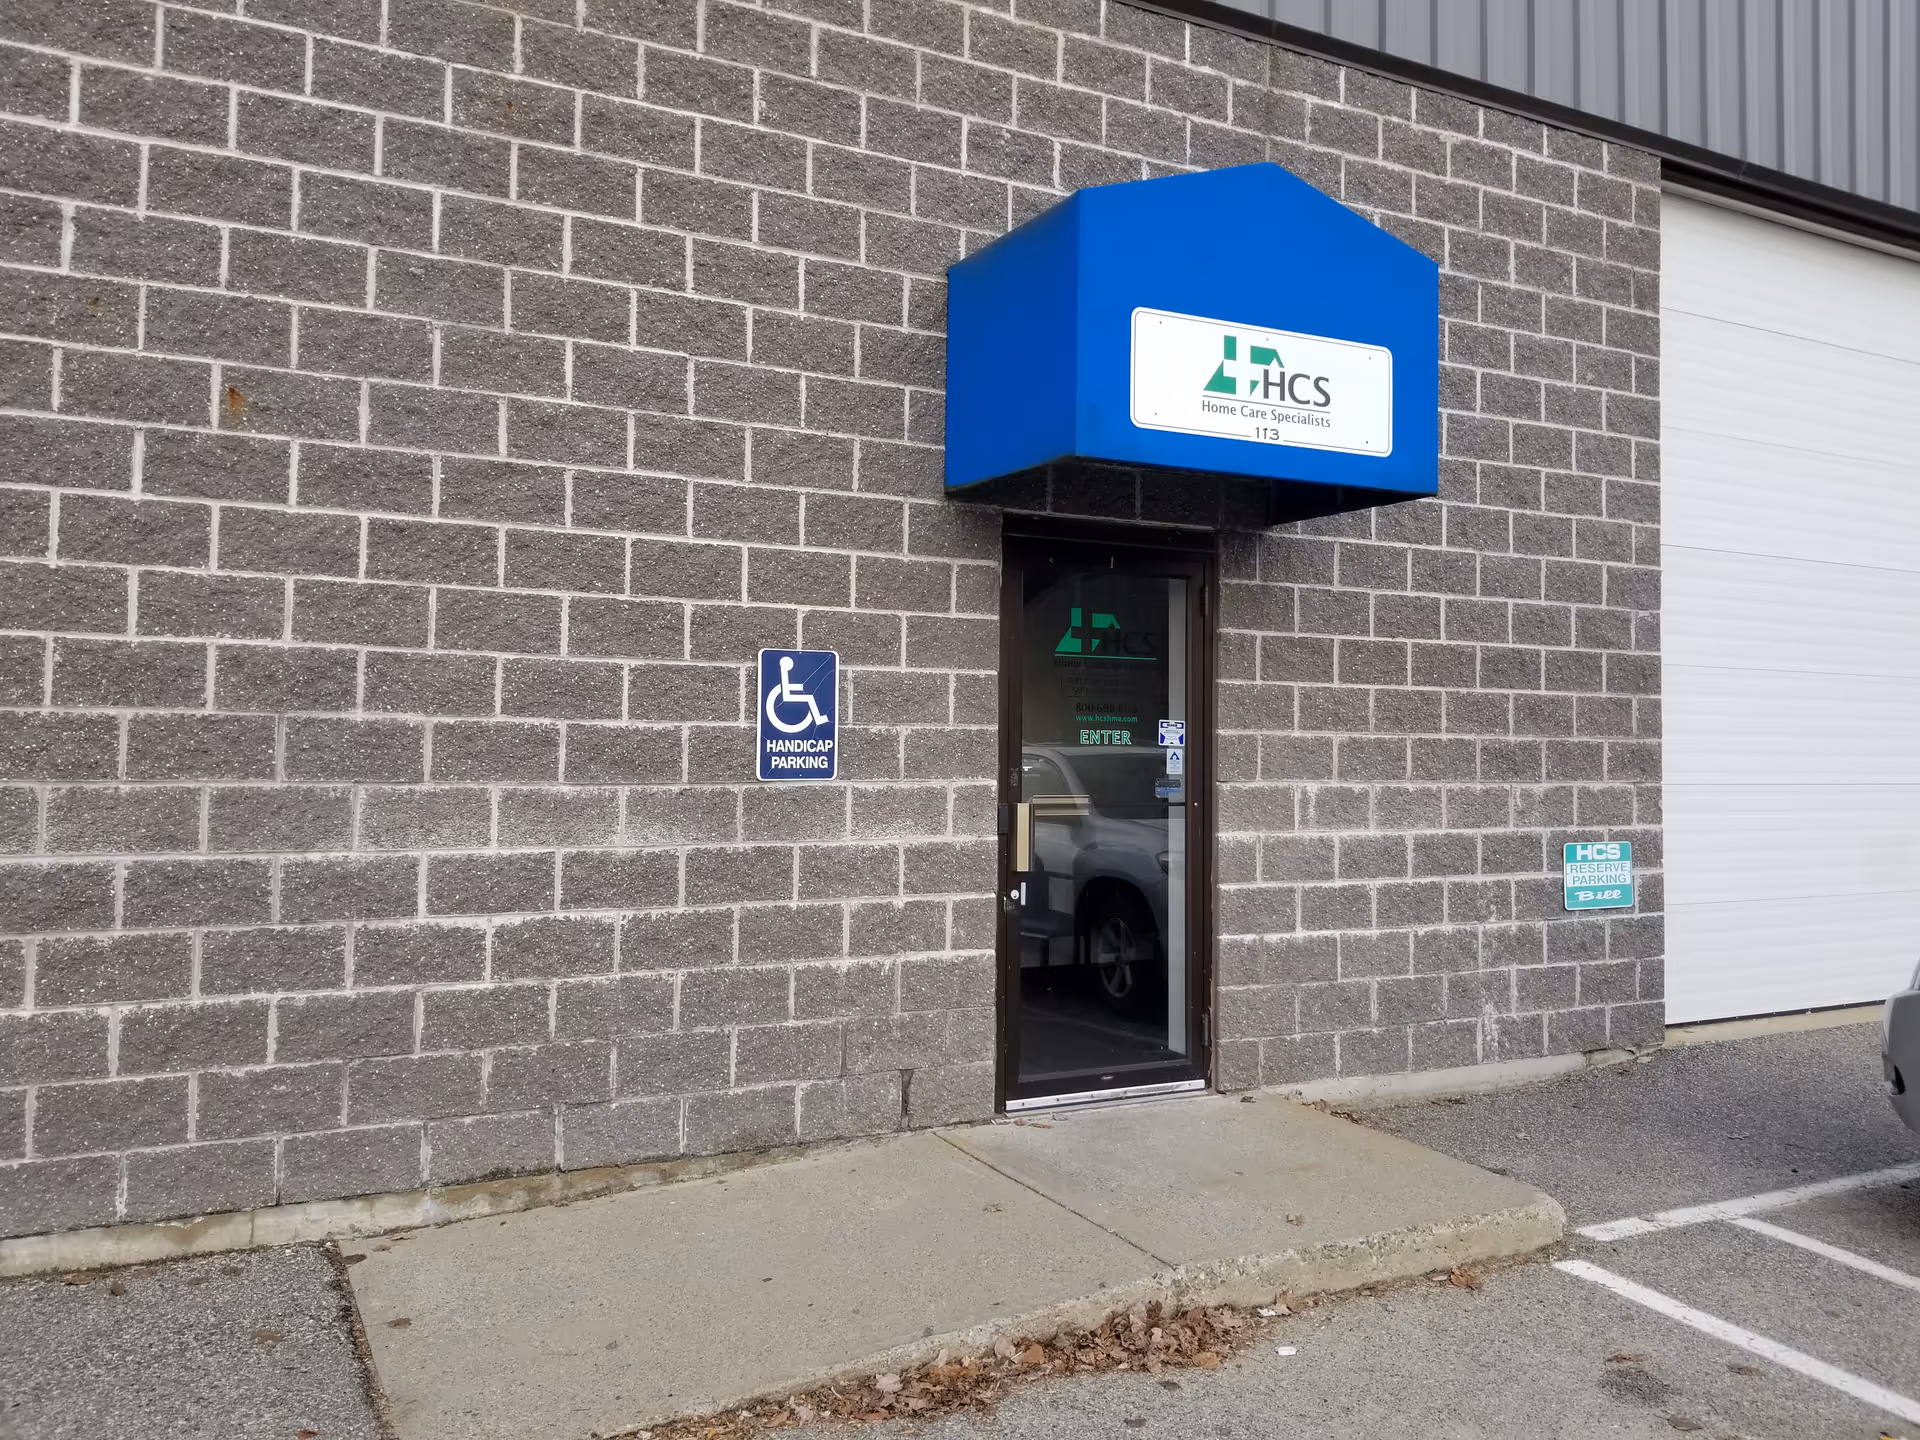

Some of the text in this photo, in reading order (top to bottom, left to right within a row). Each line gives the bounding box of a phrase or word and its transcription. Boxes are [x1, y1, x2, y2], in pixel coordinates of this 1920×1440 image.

[1263, 369, 1331, 407] HCS
[1202, 400, 1331, 428] Home Care Specialists
[1255, 427, 1280, 440] 113
[1102, 630, 1156, 656] HCS
[1076, 714, 1138, 723] www.hcshme.com
[1080, 729, 1132, 745] ENTER
[766, 740, 834, 753] HANDICAP
[771, 756, 829, 769] PARKING
[1576, 843, 1621, 861] HCS
[1570, 862, 1628, 874] RESERVE
[1572, 873, 1627, 885] PARKING
